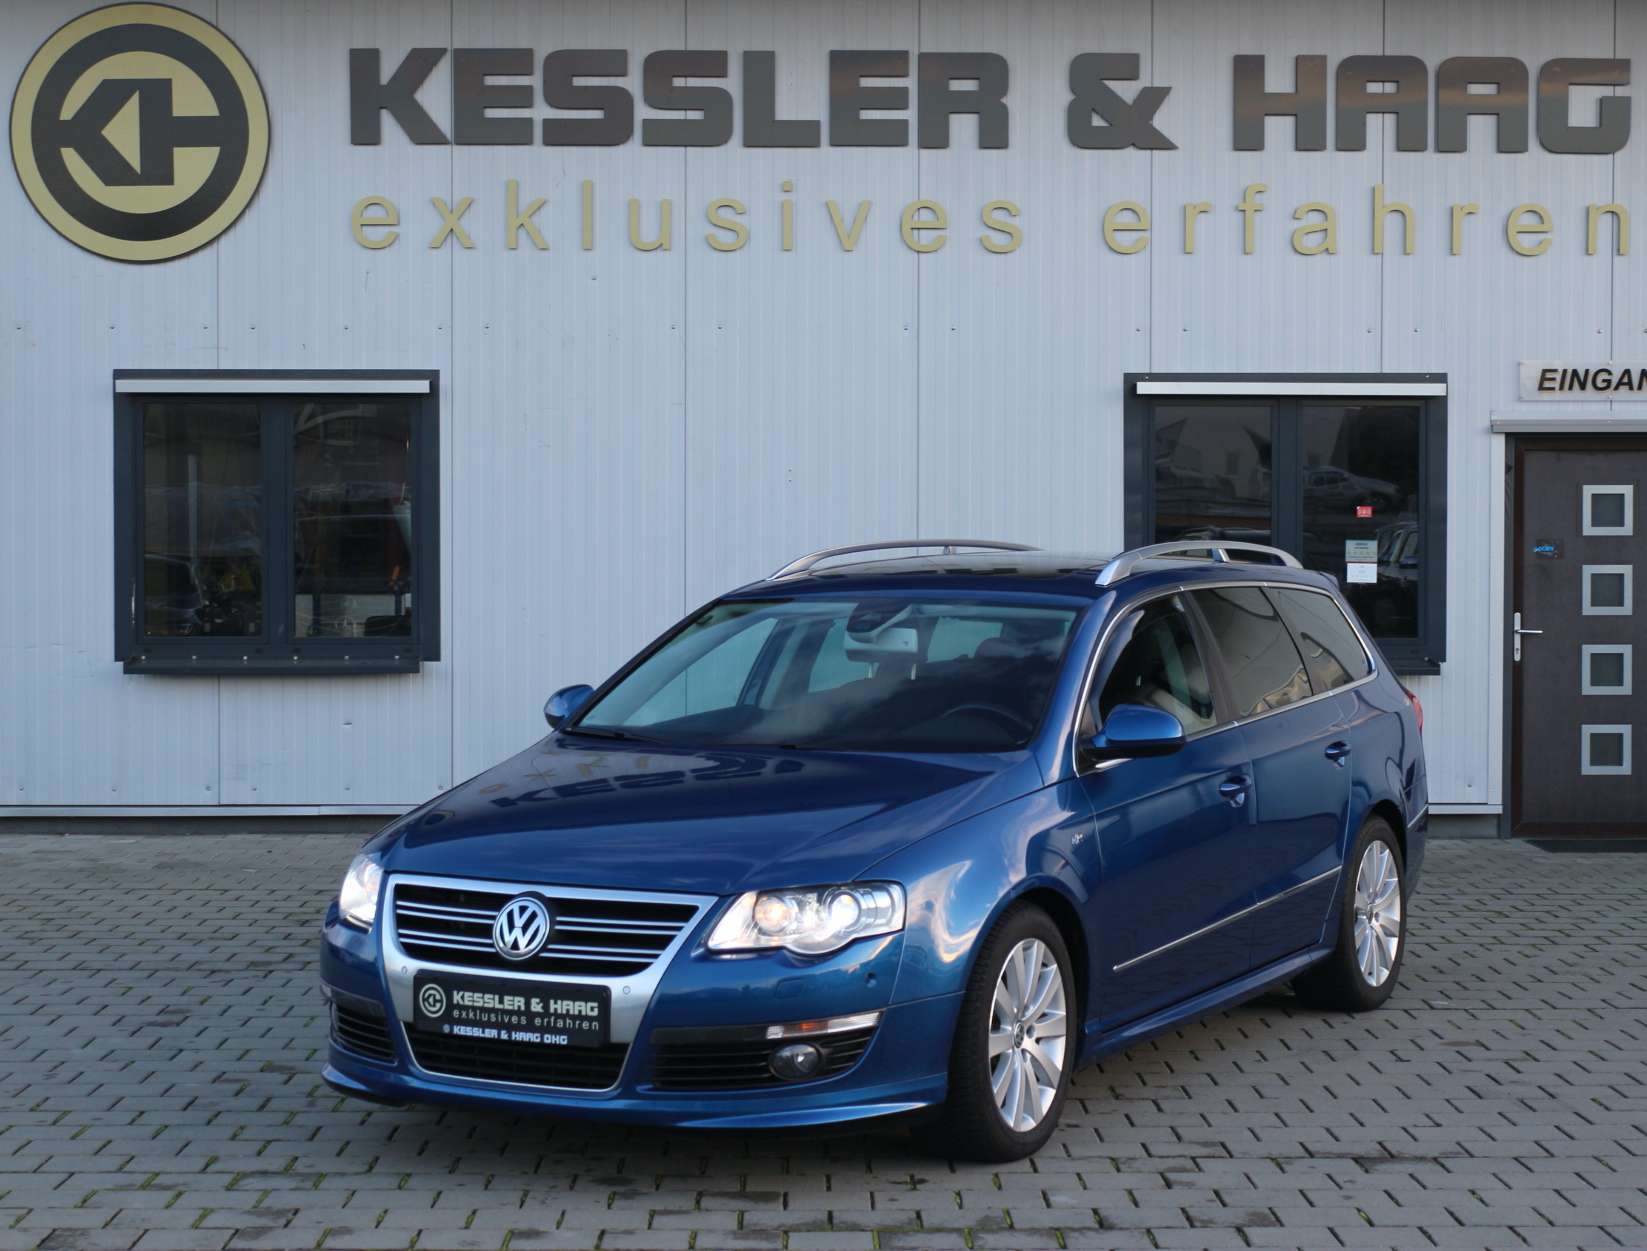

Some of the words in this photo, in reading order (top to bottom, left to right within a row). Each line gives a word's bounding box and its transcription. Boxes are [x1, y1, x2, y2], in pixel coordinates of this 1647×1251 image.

[349, 47, 1009, 150] KESSLER
[1067, 52, 1178, 150] &
[1232, 54, 1631, 154] HAAG
[351, 179, 1023, 254] exklusives
[1103, 184, 1630, 256] erfahren
[453, 990, 525, 1011] KESSLER
[531, 998, 544, 1013] &
[550, 1000, 599, 1016] HAAG
[453, 1009, 527, 1025] exklusives
[535, 1017, 599, 1031] erfahren
[453, 1025, 498, 1039] KESSLER
[512, 1031, 541, 1043] HAAG
